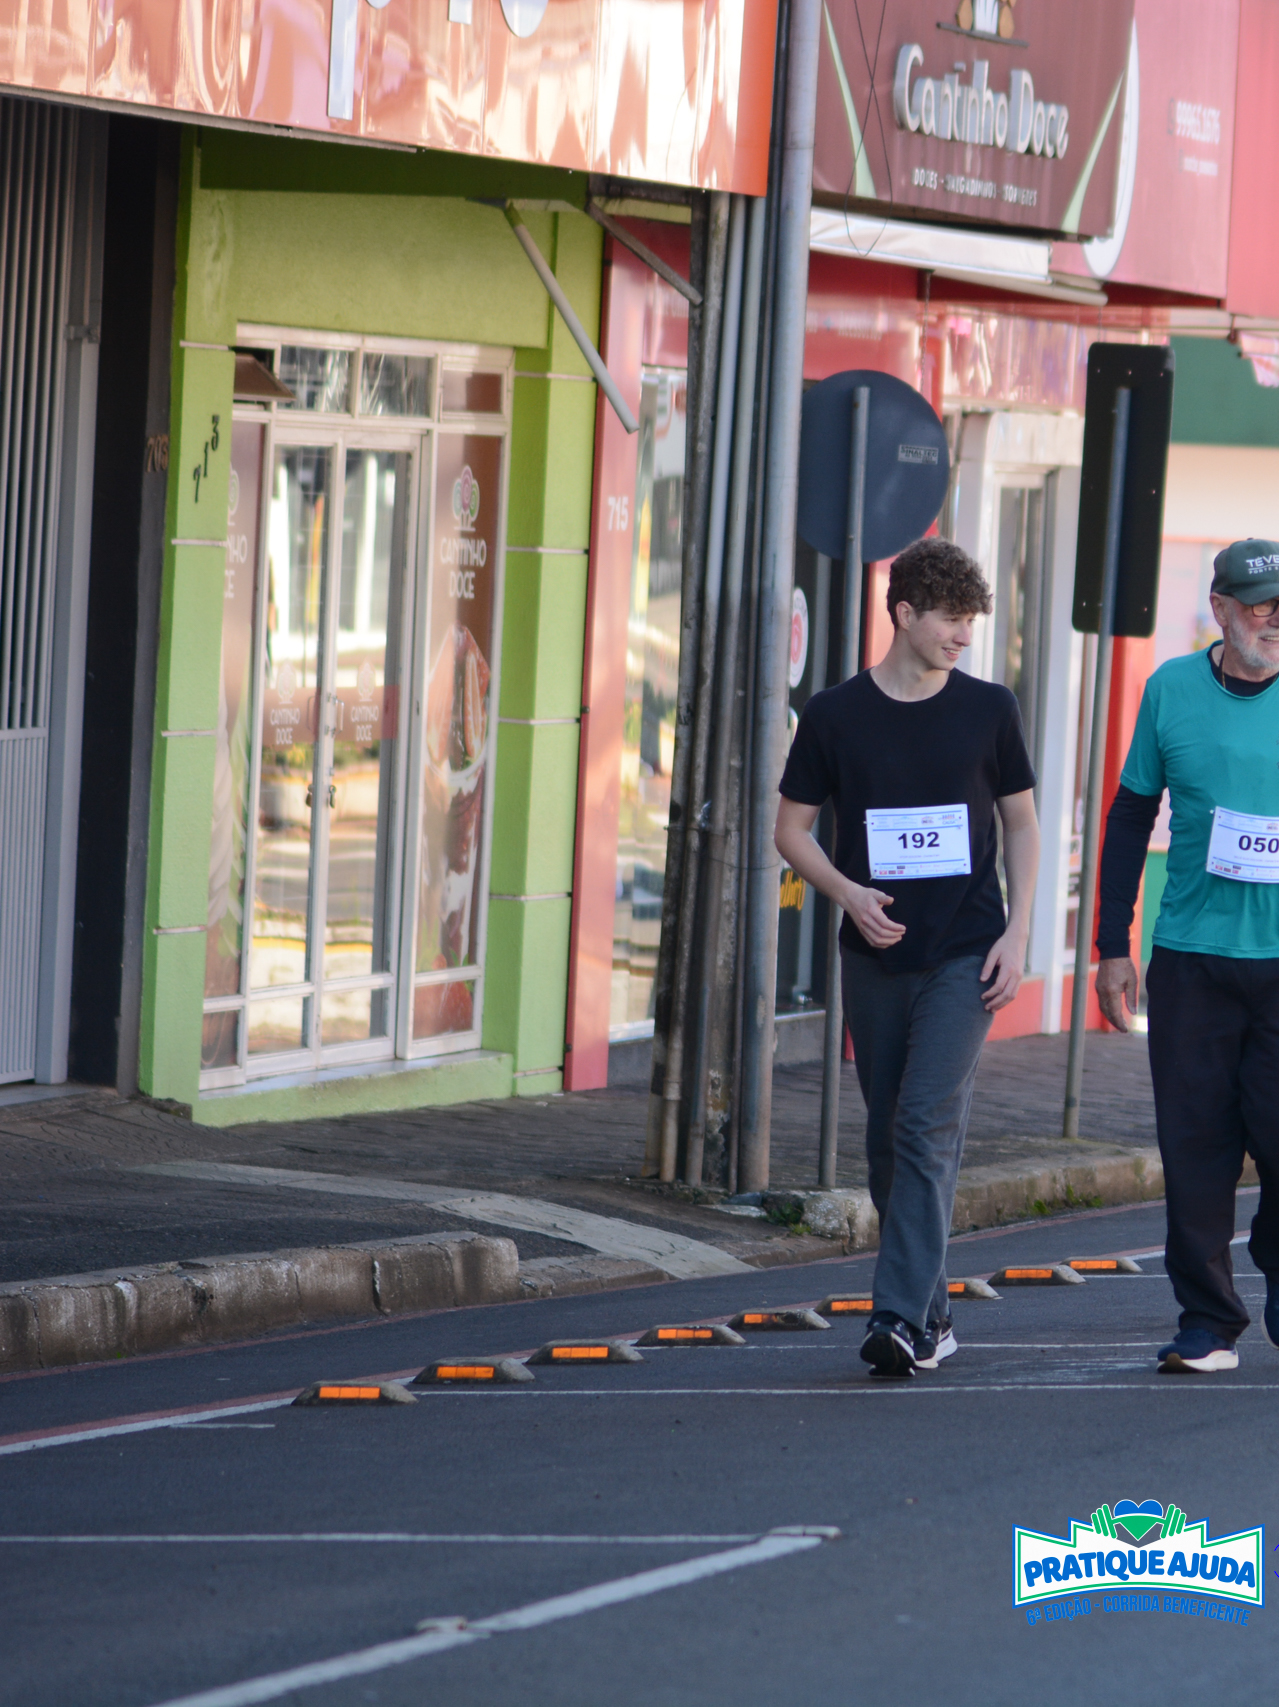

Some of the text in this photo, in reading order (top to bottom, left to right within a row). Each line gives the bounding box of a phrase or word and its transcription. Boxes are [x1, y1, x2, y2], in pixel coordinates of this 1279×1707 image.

[893, 43, 1069, 160] Cantinho Doce
[913, 167, 938, 190] DOCES
[607, 496, 629, 531] 715
[441, 538, 487, 568] CANTINHO
[450, 570, 476, 599] DOCE
[898, 831, 940, 849] 192
[1238, 835, 1279, 854] 050
